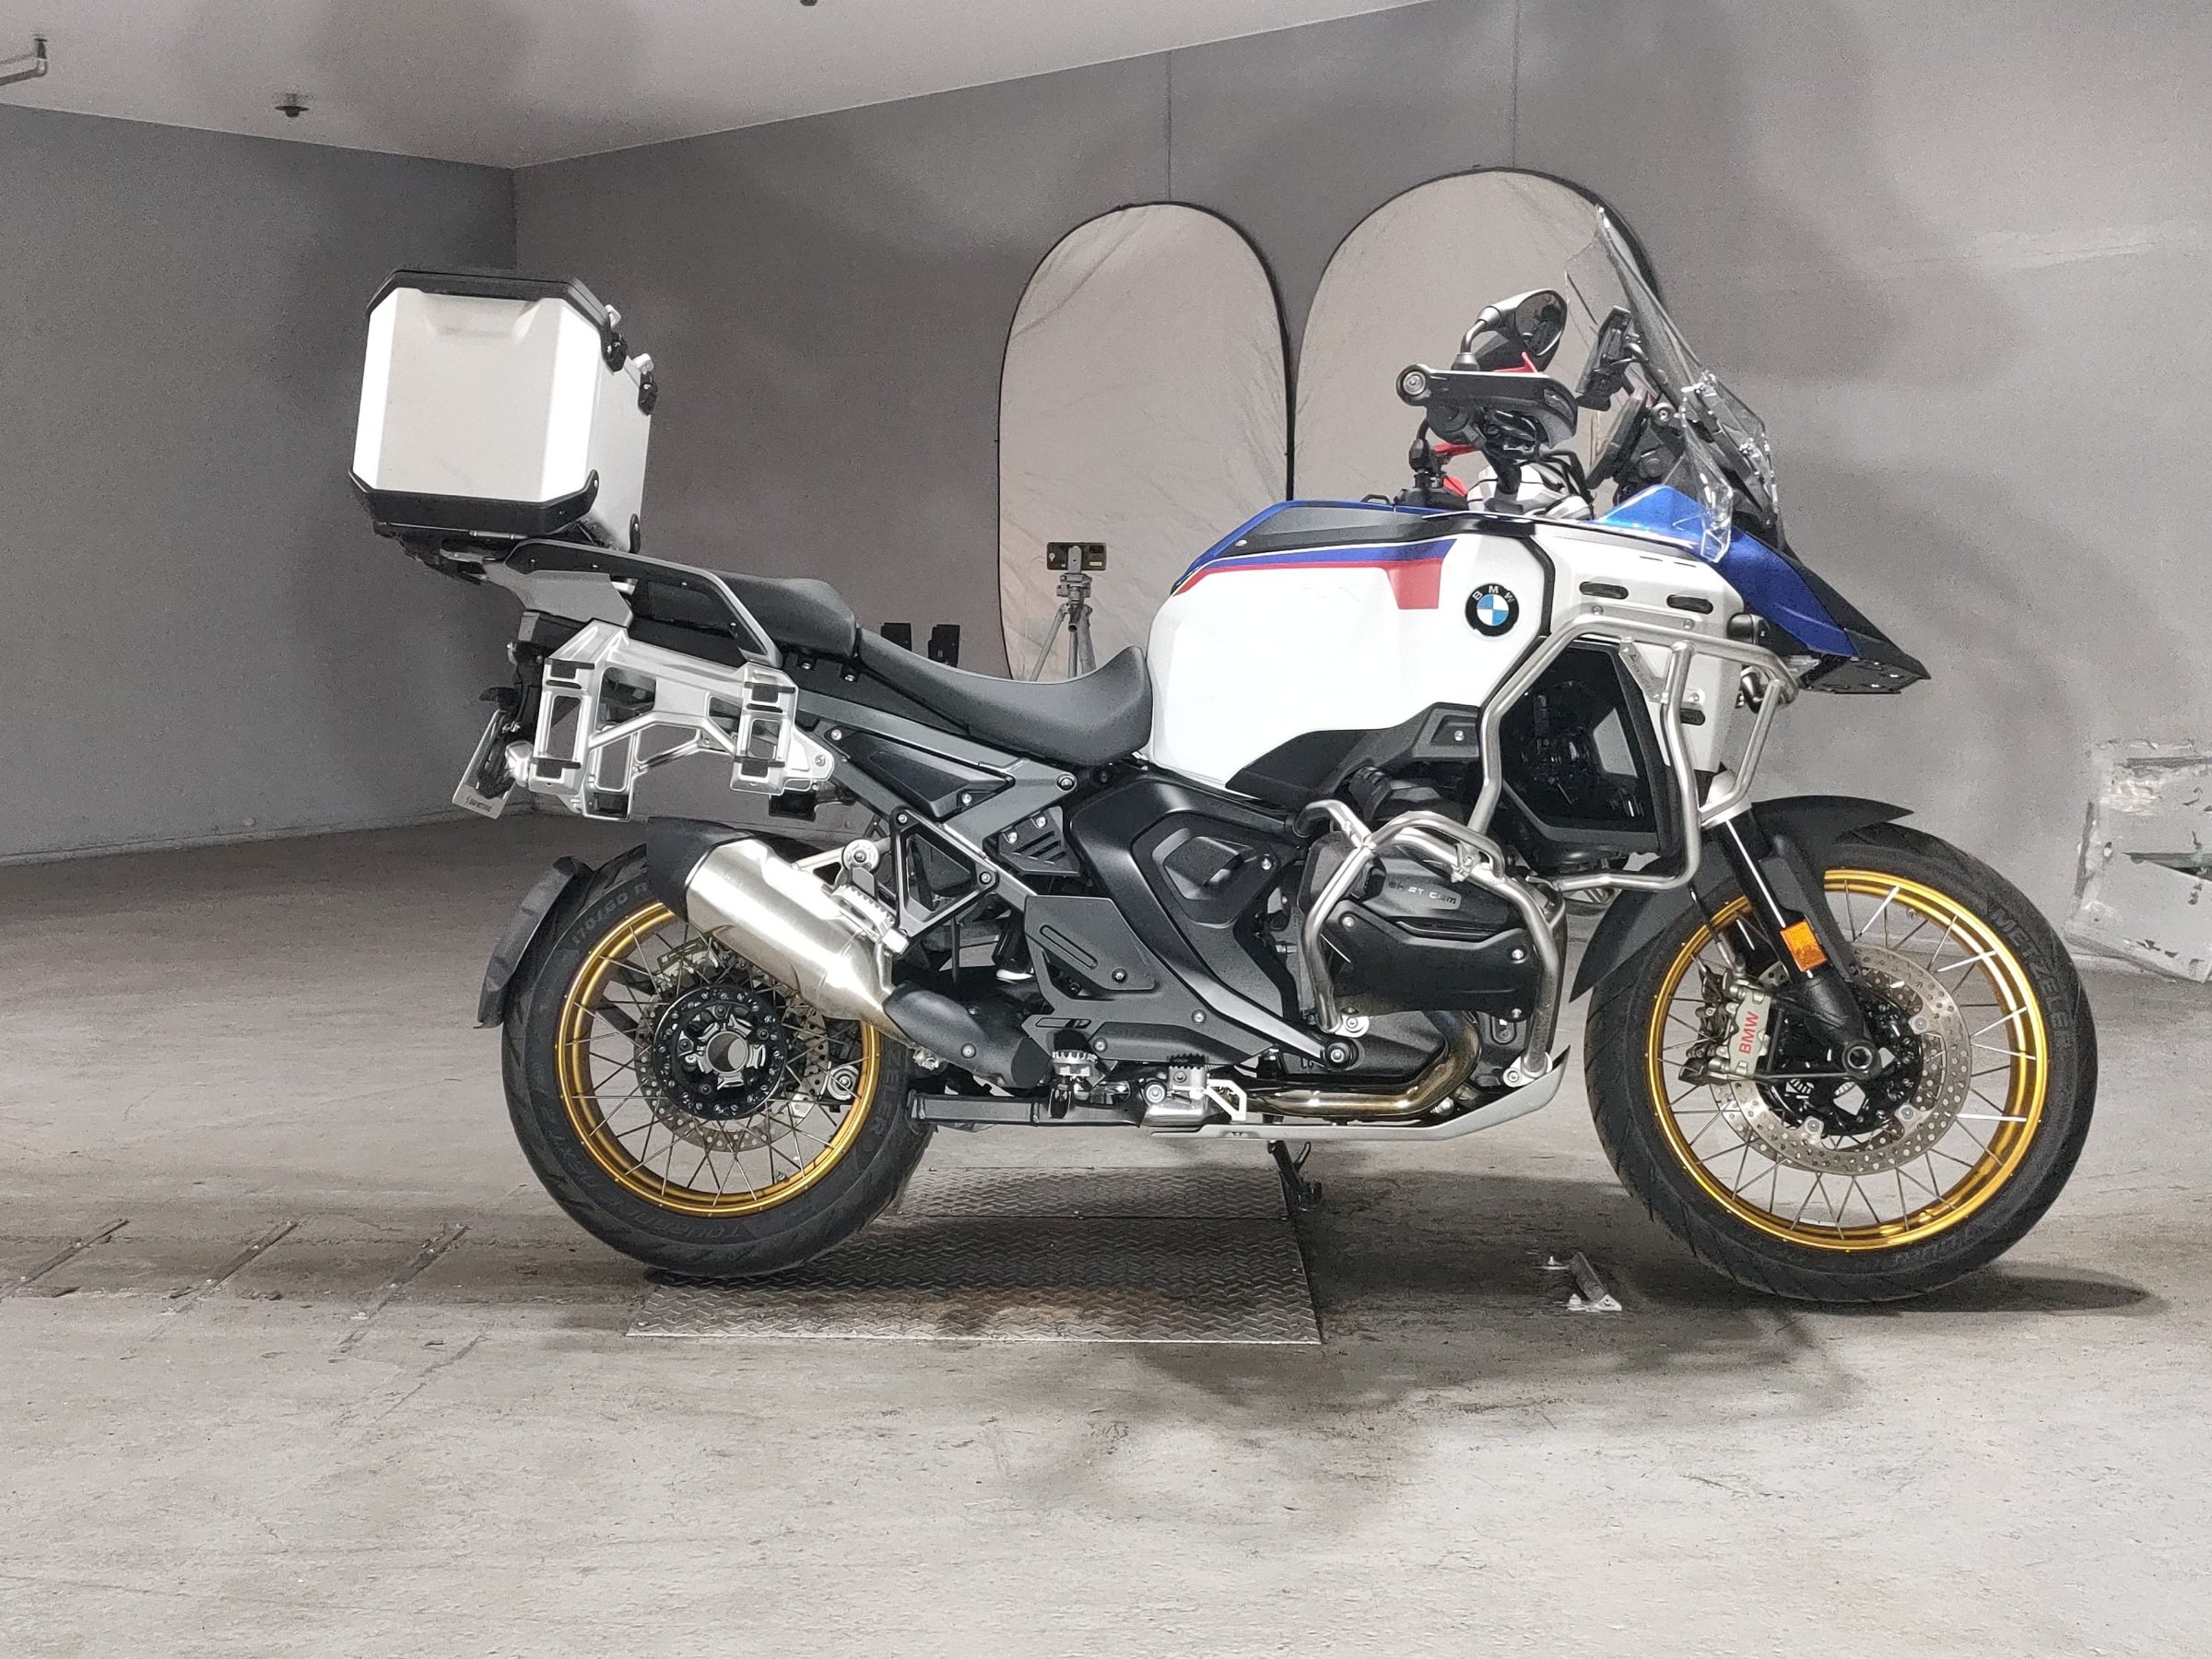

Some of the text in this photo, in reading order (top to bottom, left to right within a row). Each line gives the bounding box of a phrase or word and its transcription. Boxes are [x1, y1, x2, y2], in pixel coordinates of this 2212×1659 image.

[1472, 586, 1514, 603] BMW
[1738, 1012, 1759, 1054] BMW
[868, 1048, 900, 1135] ZELER
